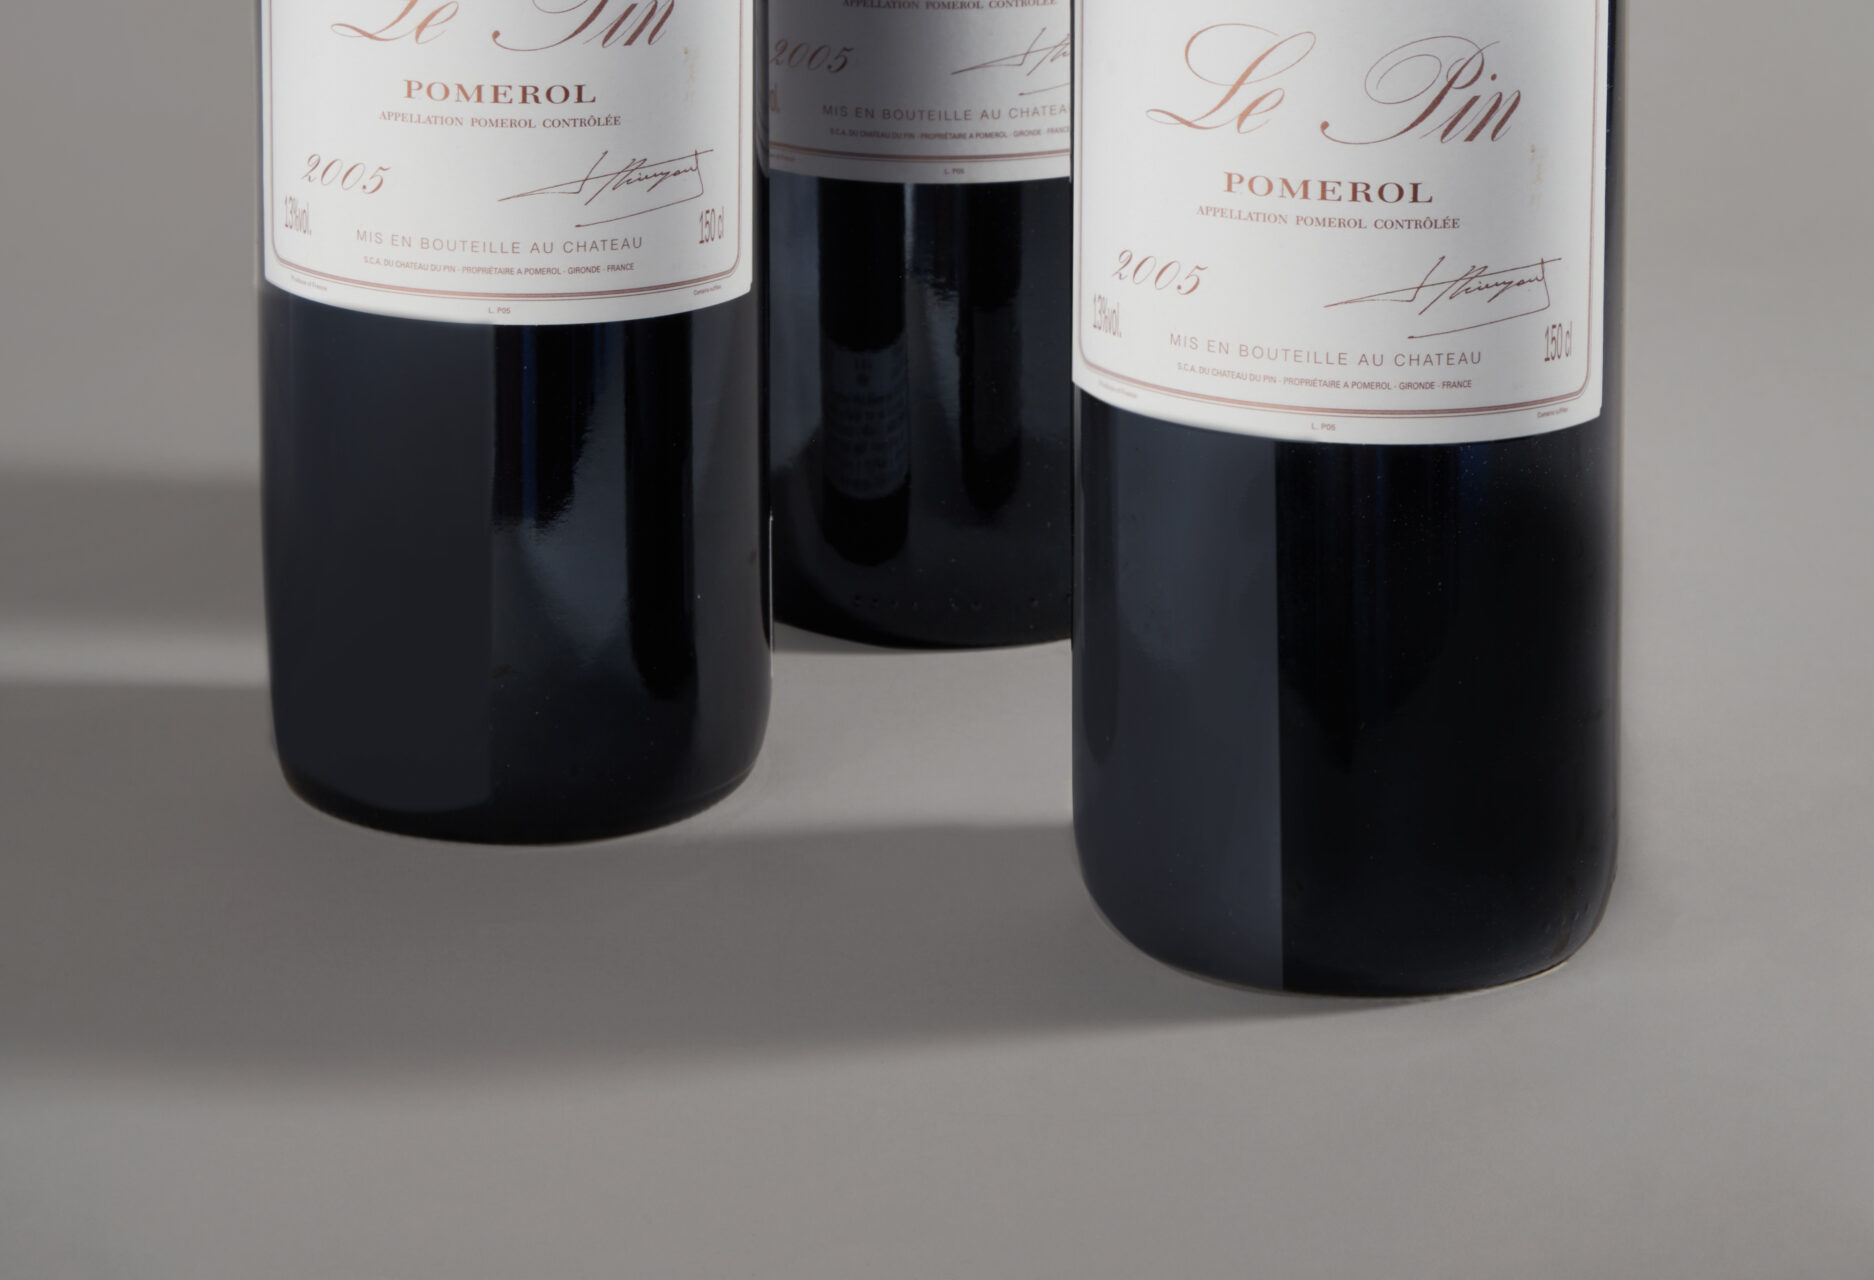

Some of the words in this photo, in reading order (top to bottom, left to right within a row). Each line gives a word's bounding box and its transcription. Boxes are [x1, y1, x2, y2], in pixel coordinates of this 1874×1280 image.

[925, 0, 984, 10] POMEROL
[769, 39, 854, 74] 2005
[402, 79, 596, 104] POMEROL
[1146, 23, 1317, 134] Le
[1320, 35, 1521, 145] Pin
[379, 110, 464, 127] APPELLATION
[470, 116, 537, 129] POMEROL
[542, 113, 622, 129] CONTRÔLÉE
[822, 104, 848, 117] MIS
[855, 106, 875, 119] EN
[882, 108, 972, 120] BOUTEILLE
[980, 109, 1000, 120] AU
[1008, 104, 1069, 119] CHATEA
[300, 153, 391, 195] 2005
[1223, 171, 1433, 204] POMEROL
[699, 208, 716, 244] 150
[717, 206, 725, 240] cl
[1196, 205, 1288, 225] APPELLATION
[1295, 215, 1367, 230] POMEROL
[1373, 215, 1461, 230] CONTRÔLÉE
[356, 228, 383, 245] MIS
[391, 234, 412, 248] EN
[420, 237, 520, 254] BOUTEILLE
[530, 241, 554, 254] AU
[563, 236, 642, 254] CHATEAU
[384, 259, 394, 267] DU
[395, 260, 429, 271] CHATEAU
[430, 264, 441, 272] DU
[443, 265, 456, 273] PIN
[462, 265, 514, 275] PROPRIÉTAIRE
[524, 267, 561, 275] POMEROL
[567, 266, 601, 275] GIRONDE
[606, 262, 635, 272] FRANCE
[1112, 249, 1208, 295] 2005
[1170, 332, 1199, 351] MIS
[1207, 339, 1229, 355] EN
[1239, 343, 1347, 366] BOUTEILLE
[1358, 353, 1384, 367] AU
[1394, 351, 1481, 367] CHATEAU
[1544, 323, 1563, 362] 150
[1565, 320, 1573, 358] cl
[1199, 365, 1210, 375] DU
[1211, 368, 1248, 381] CHATEAU
[1249, 373, 1261, 382] DU
[1263, 374, 1277, 384] PIN
[1283, 376, 1340, 388] PROPRIÉTAIRE
[1343, 380, 1350, 388] A
[1351, 381, 1392, 390] POMEROL
[1400, 381, 1436, 390] GIRONDE
[1442, 380, 1472, 389] FRANCE
